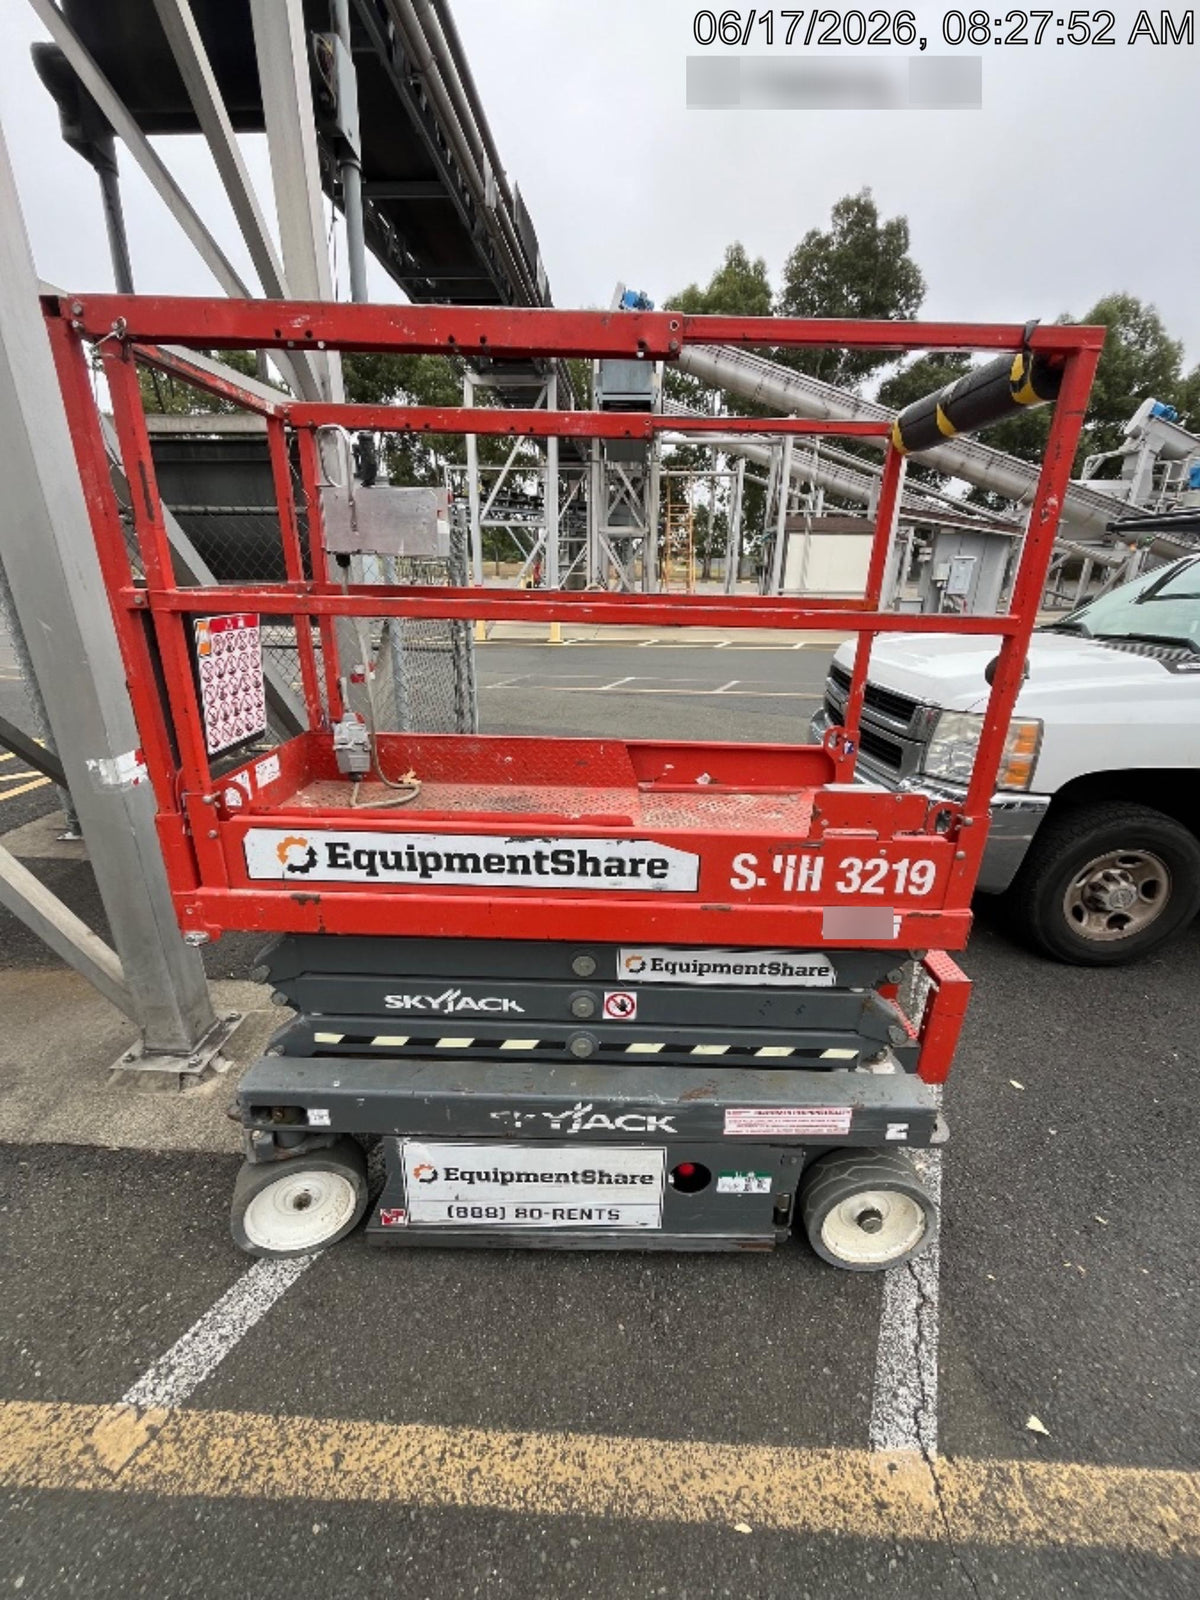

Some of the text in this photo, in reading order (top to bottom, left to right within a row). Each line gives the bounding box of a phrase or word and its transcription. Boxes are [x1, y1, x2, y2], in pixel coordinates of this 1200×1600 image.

[324, 841, 670, 880] EquipmentShare
[836, 857, 937, 895] 3219
[650, 957, 831, 977] EquipmentShare
[384, 988, 526, 1013] SKYJACK
[443, 1166, 655, 1186] EquipmentShare
[515, 1207, 621, 1221] 80-RENTS
